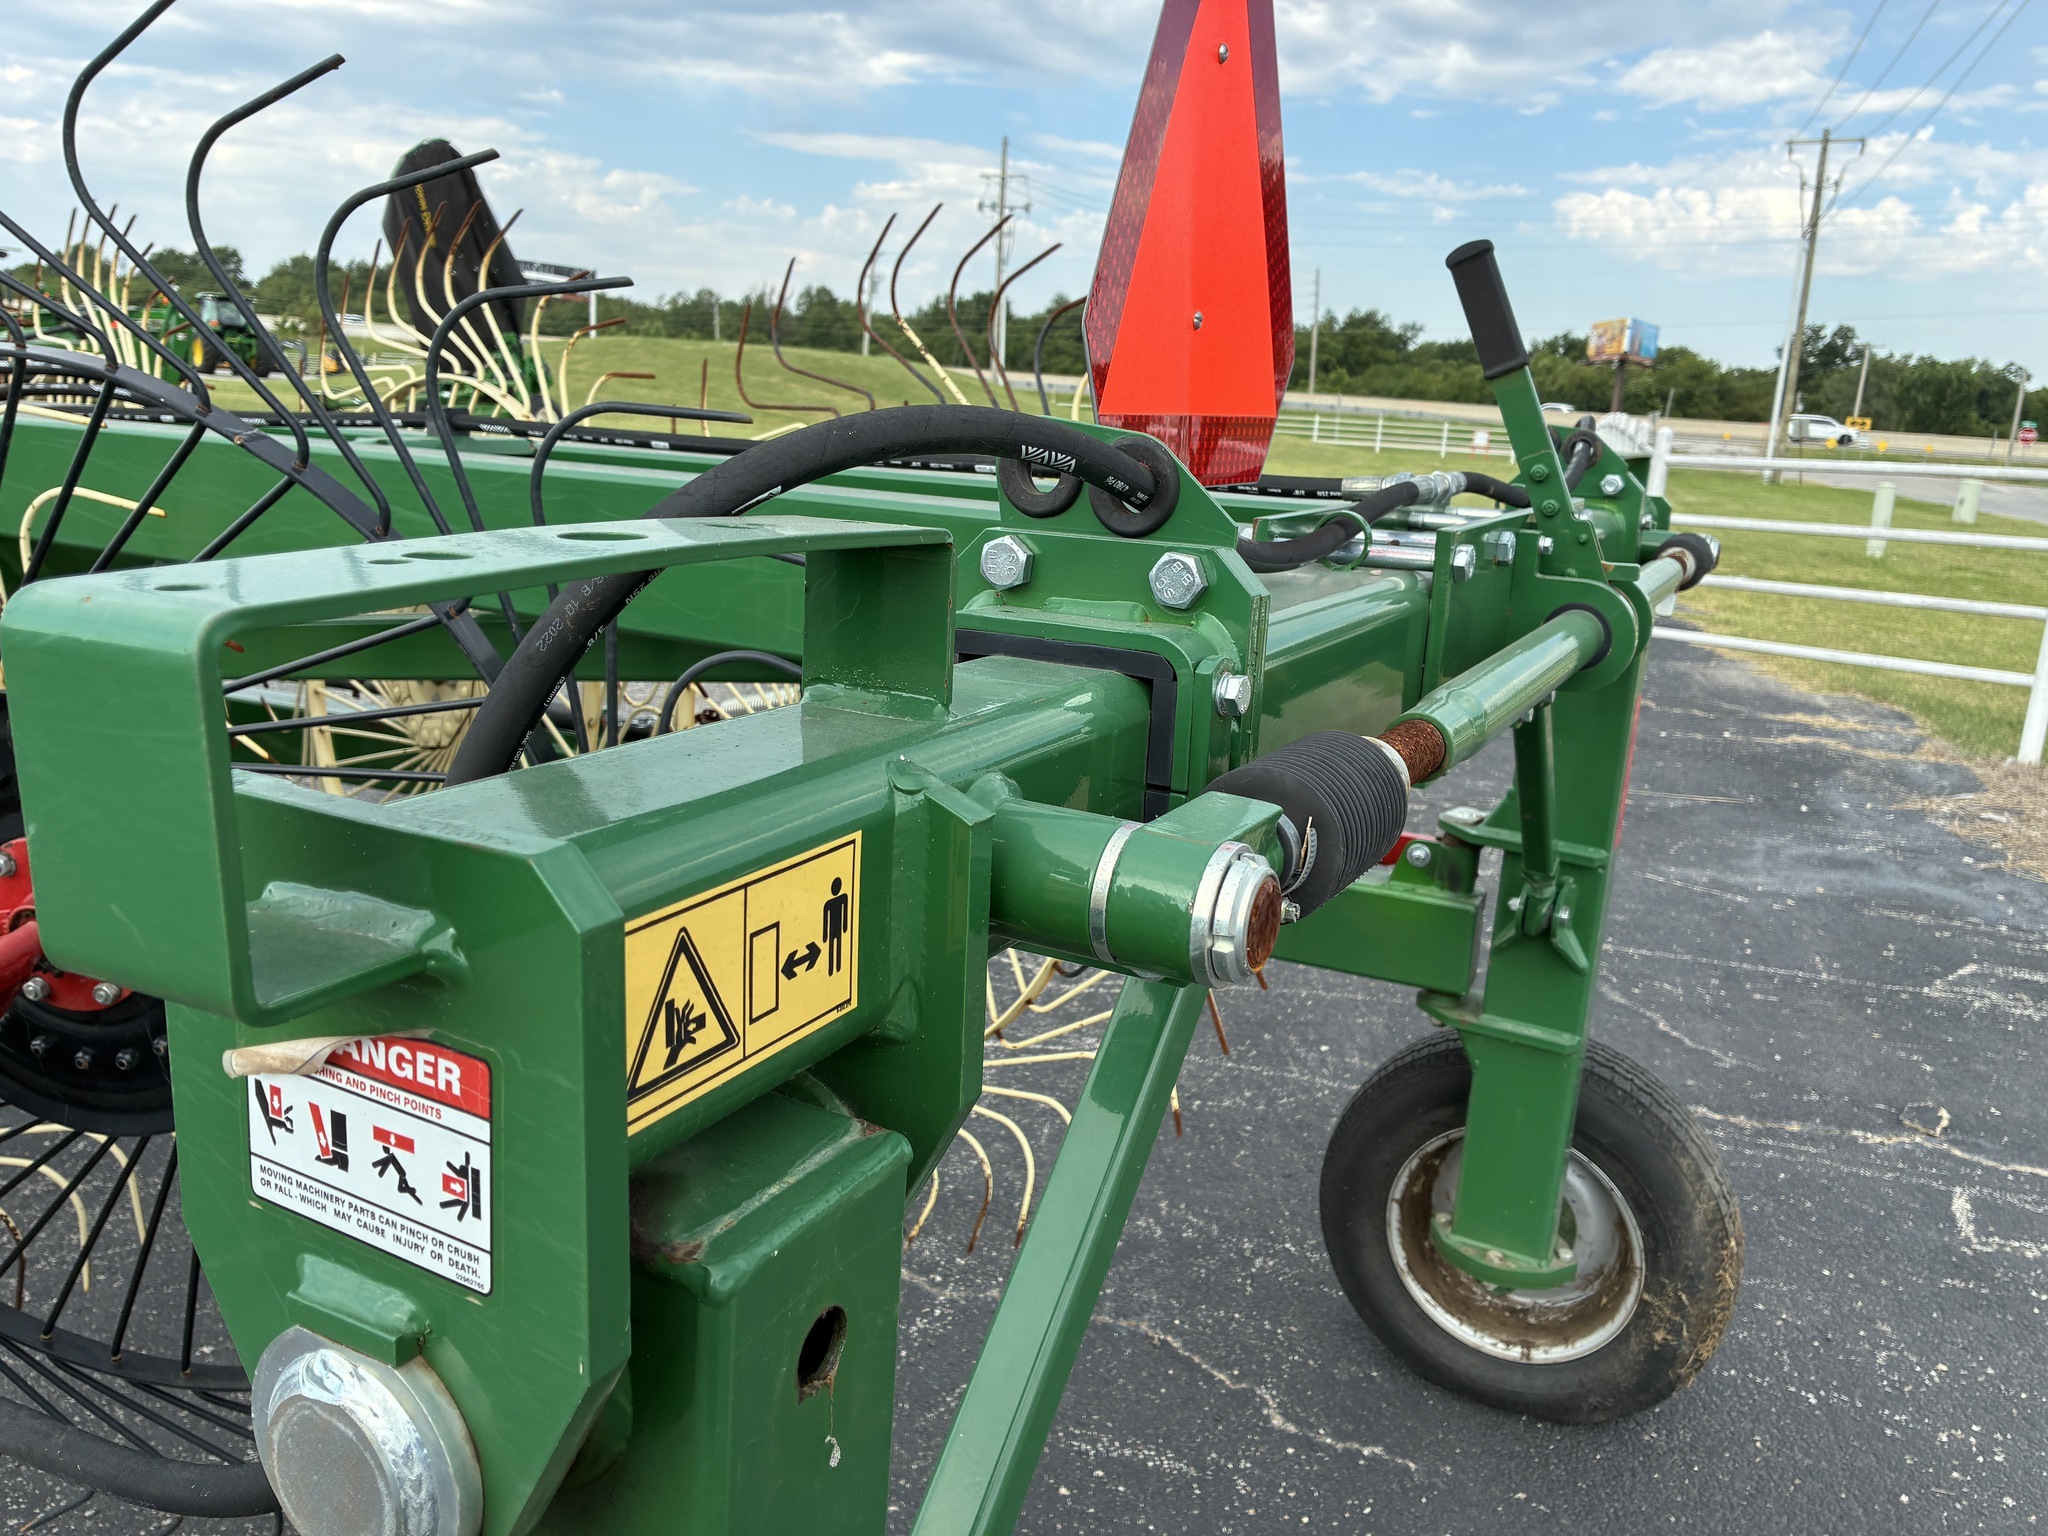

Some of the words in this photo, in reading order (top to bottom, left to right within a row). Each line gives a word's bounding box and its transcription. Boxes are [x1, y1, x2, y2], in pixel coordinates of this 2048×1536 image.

[535, 617, 564, 652] 2022
[335, 1038, 462, 1097] ANGER
[345, 1077, 367, 1092] AND
[369, 1085, 401, 1105] PINCH
[403, 1096, 442, 1120] POINTS
[260, 1164, 293, 1185] MOVING
[295, 1179, 345, 1207] MACHINERY
[348, 1201, 376, 1221] PARTS
[378, 1214, 398, 1230] CAN
[400, 1223, 429, 1243] PINCH
[431, 1237, 445, 1251] OR
[447, 1244, 480, 1265] CRUSH
[260, 1177, 272, 1189] OR
[274, 1184, 293, 1199] FALL
[299, 1193, 327, 1213] WHICH
[333, 1208, 352, 1223] MAY
[356, 1217, 386, 1239] CAUSE
[392, 1233, 425, 1255] INJURY
[430, 1250, 443, 1263] OR
[448, 1257, 481, 1279] DEATH.
